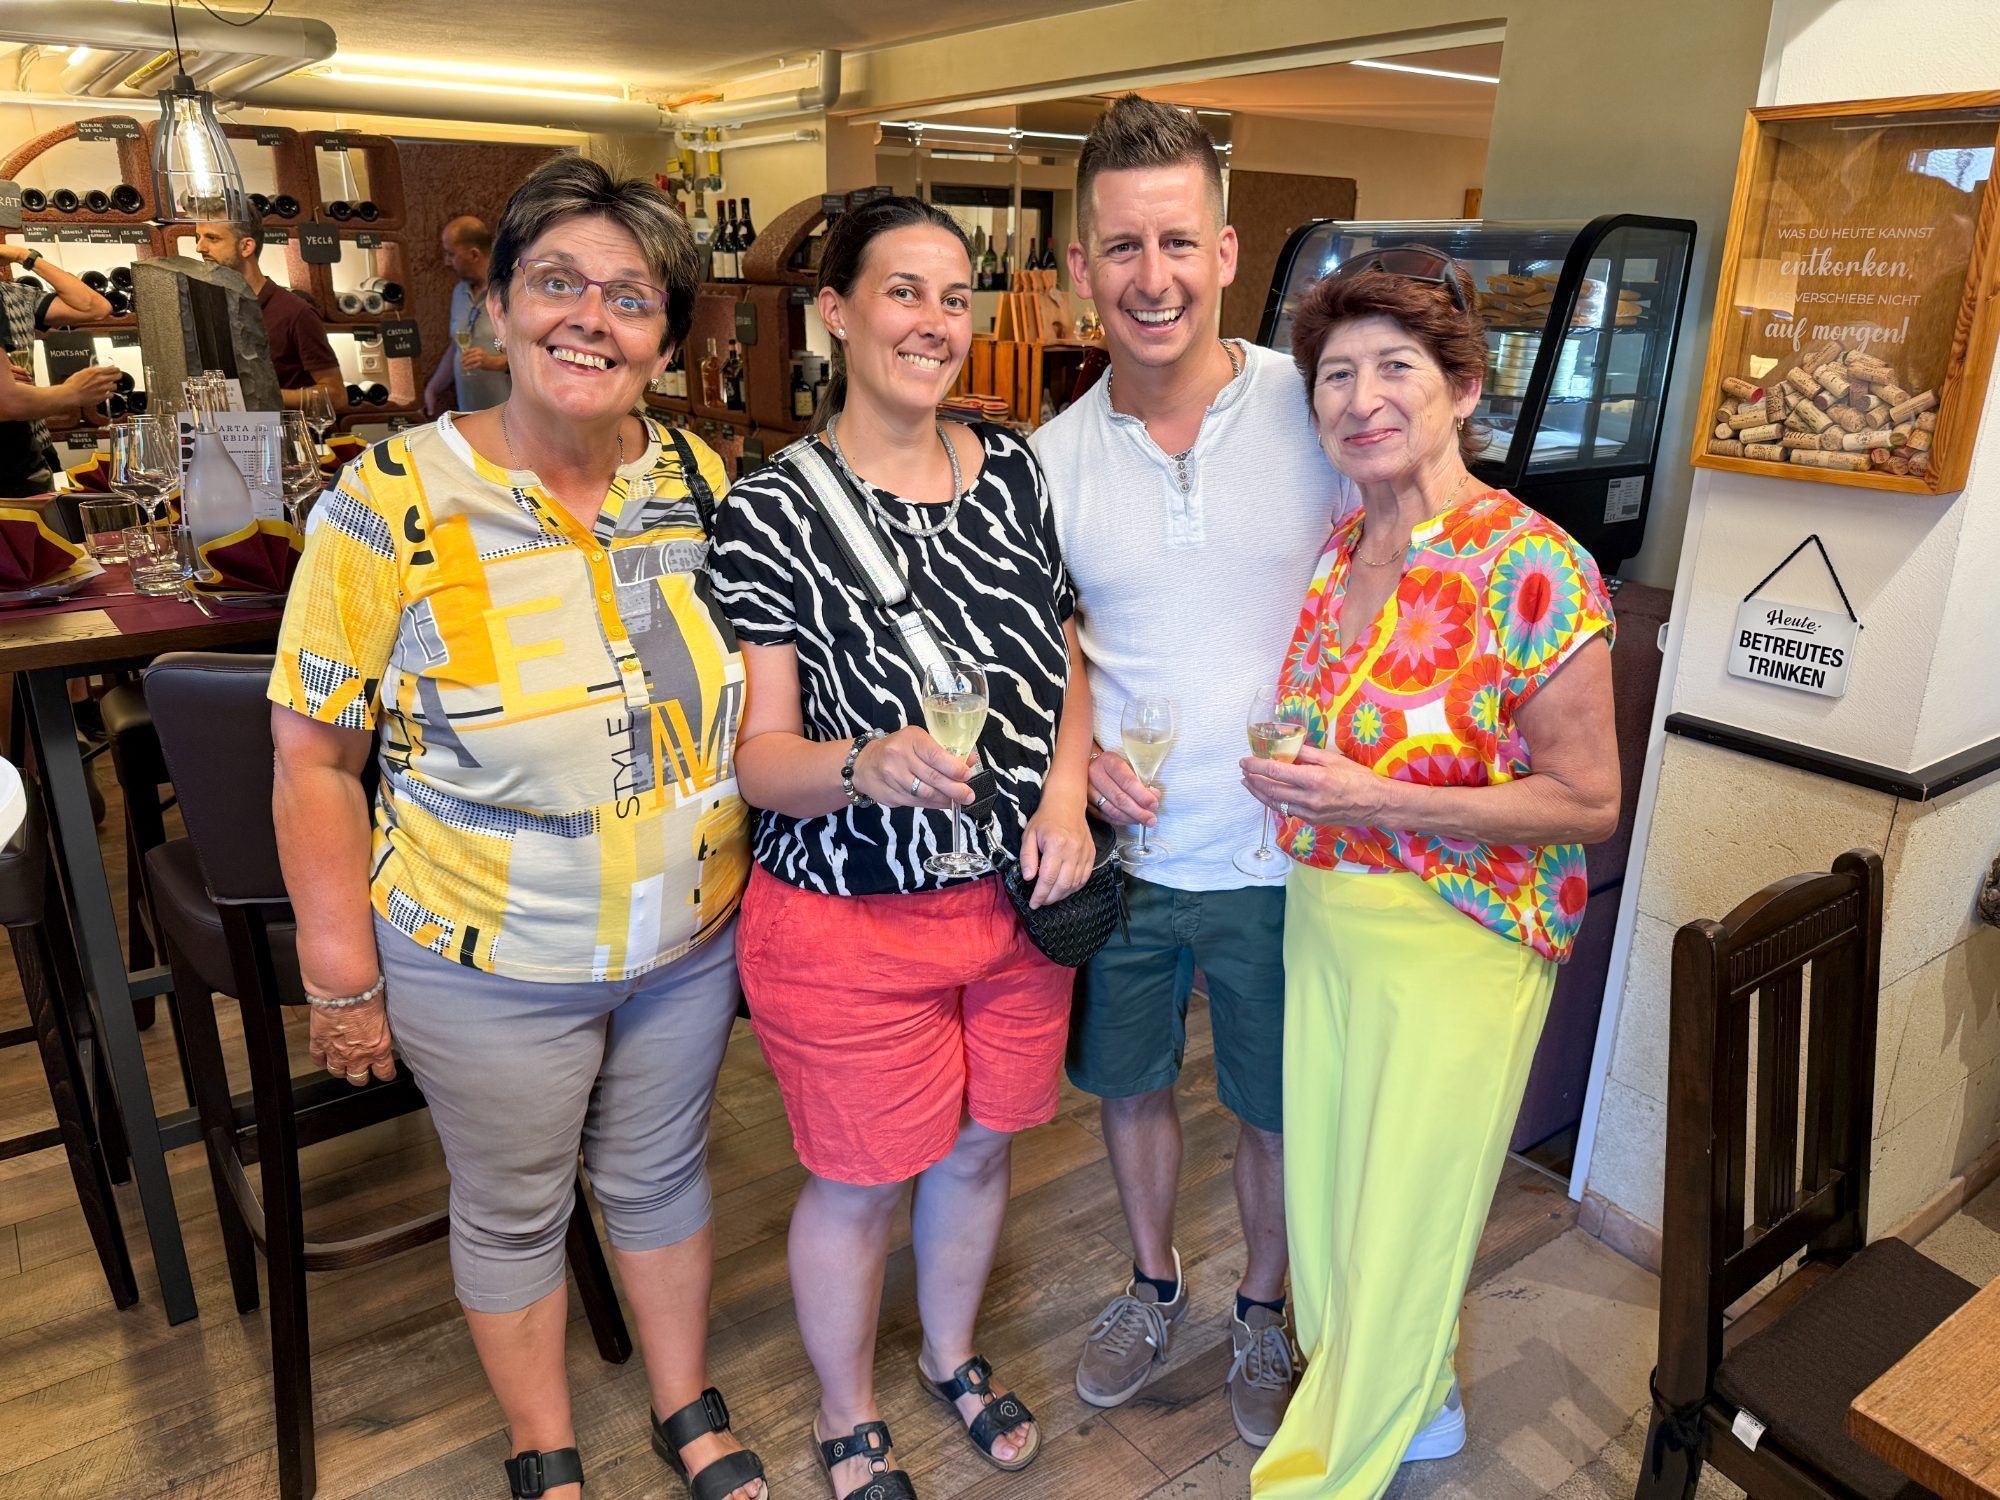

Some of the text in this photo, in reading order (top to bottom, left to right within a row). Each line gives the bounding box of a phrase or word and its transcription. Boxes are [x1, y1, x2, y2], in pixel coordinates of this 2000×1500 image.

[305, 236, 334, 246] YECLA
[1777, 227, 1936, 240] WAS DU HEUTE KANNST
[1780, 247, 1913, 281] entkorken,
[1794, 292, 1875, 305] VERSCHIEBE
[1877, 294, 1922, 306] NICHT
[386, 327, 414, 337] CASTILLA
[1764, 316, 1911, 354] auf morgen!
[49, 349, 90, 359] MONTSANT
[223, 434, 268, 442] EBIDAS
[1766, 609, 1822, 632] Heute:
[1739, 630, 1844, 668] BETREUTES
[1748, 654, 1826, 689] TRINKEN
[606, 711, 640, 819] STYLE
